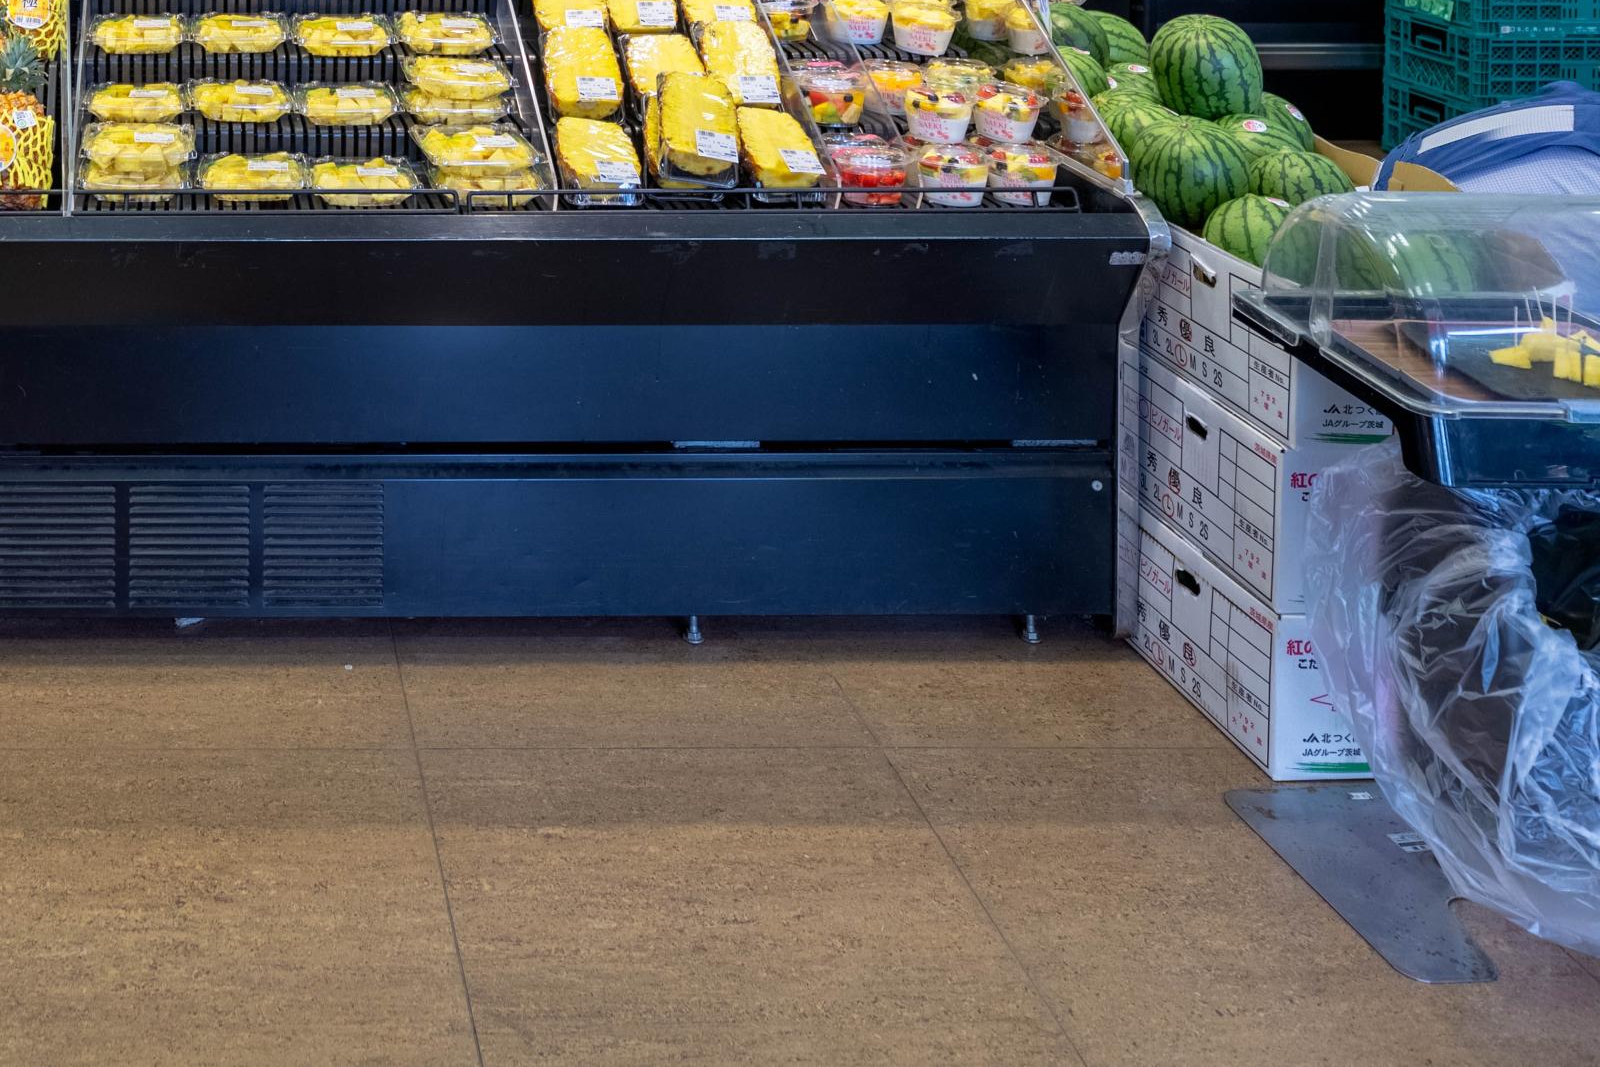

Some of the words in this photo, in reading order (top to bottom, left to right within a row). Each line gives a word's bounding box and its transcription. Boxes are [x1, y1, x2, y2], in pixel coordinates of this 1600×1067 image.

[1157, 307, 1168, 326] 秀
[1204, 335, 1216, 357] 良
[1165, 337, 1174, 356] 2L
[1190, 354, 1196, 372] M
[1201, 362, 1208, 378] S
[1213, 368, 1223, 388] 2S
[1322, 419, 1384, 429] JAグループ茨城
[1147, 449, 1158, 472] 秀
[1192, 486, 1203, 509] 良
[1153, 484, 1162, 505] 2L
[1176, 503, 1184, 520] M
[1188, 511, 1194, 528] S
[1200, 520, 1208, 540] 2S
[1158, 619, 1170, 644] 優
[1168, 655, 1175, 673] M
[1180, 667, 1186, 684] S
[1302, 748, 1360, 757] JAグループ茨城
